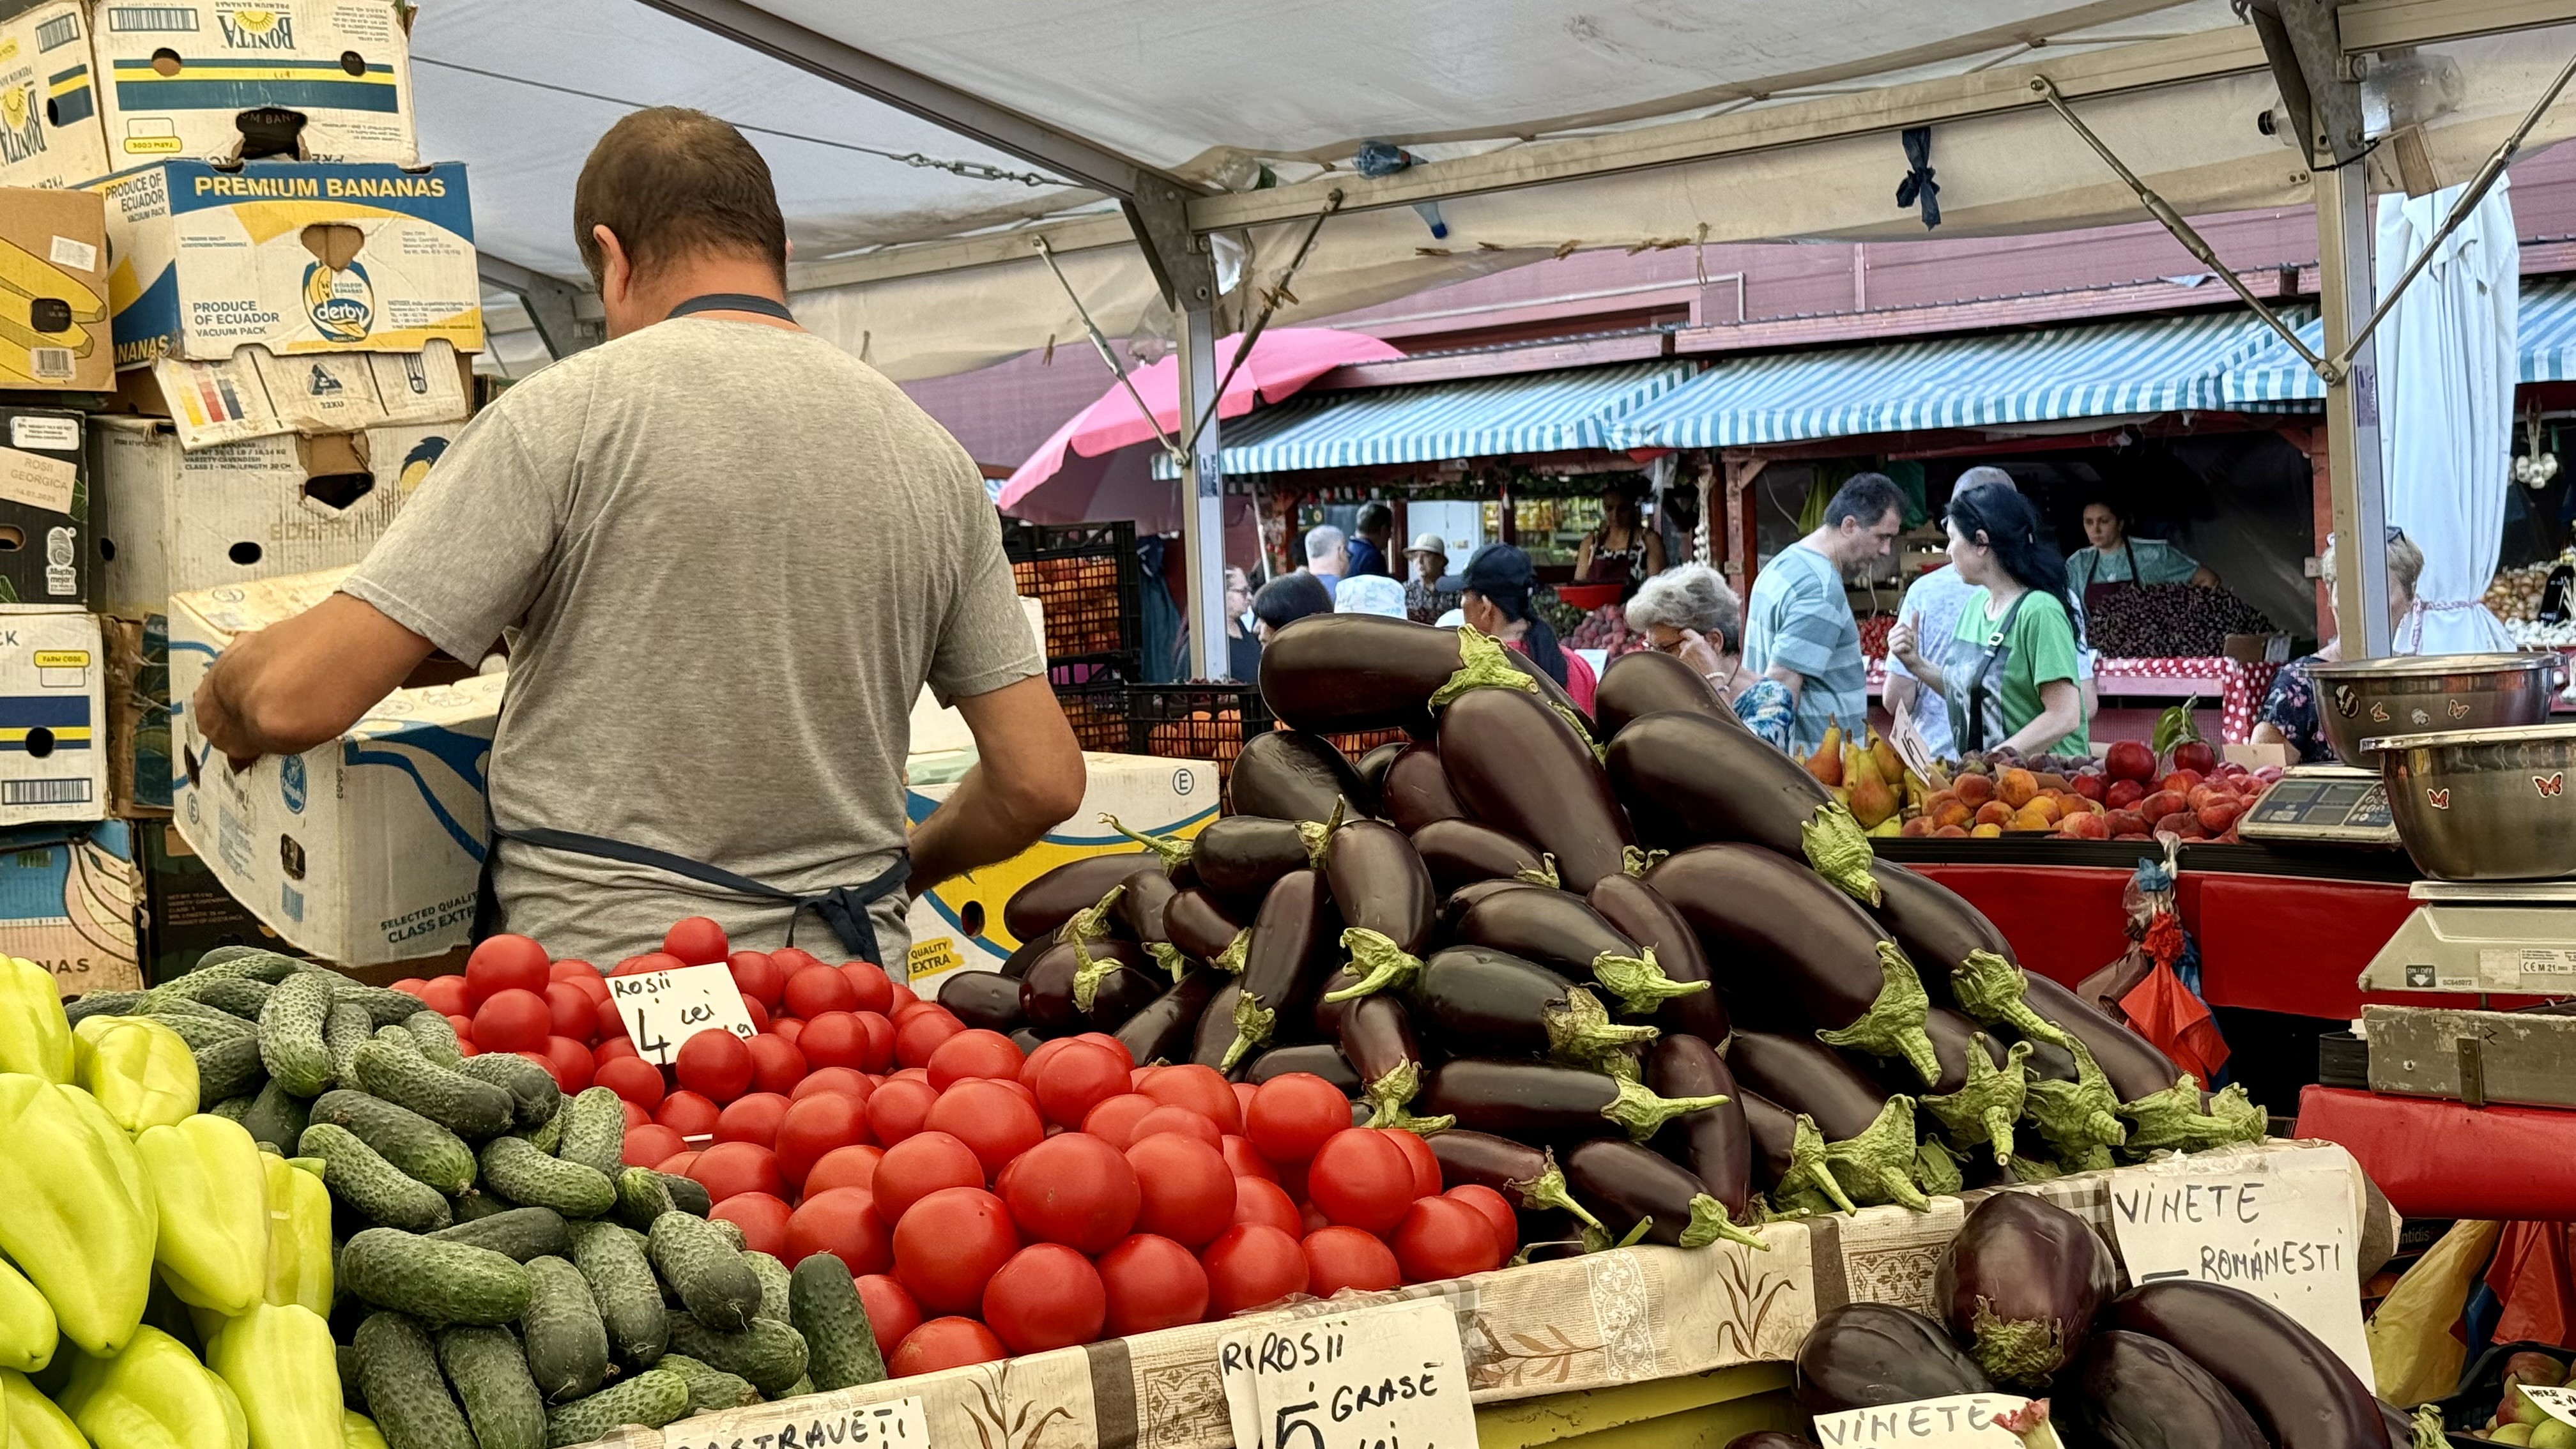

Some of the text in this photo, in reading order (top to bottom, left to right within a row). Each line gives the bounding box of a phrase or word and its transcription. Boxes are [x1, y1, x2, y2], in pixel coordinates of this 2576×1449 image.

[217, 15, 296, 50] BONITA
[105, 172, 163, 200] PRODUCE OF
[194, 176, 447, 198] PREMIUM BANANAS
[121, 188, 165, 213] ECUADOR
[127, 209, 150, 224] VACUUM
[193, 300, 257, 313] PRODUCE
[194, 312, 280, 325] OF ECUADOR
[317, 300, 365, 328] derby
[195, 326, 267, 337] VACUUM PACK
[11, 470, 68, 491] GEORGICA
[380, 906, 436, 931] SELECTED
[388, 918, 436, 943] CLASS
[910, 940, 948, 960] QUALITY
[911, 953, 951, 974] EXTRA
[638, 1008, 671, 1065] 4
[2114, 1182, 2265, 1224] VINETE
[1821, 1399, 1991, 1446] VINETE
